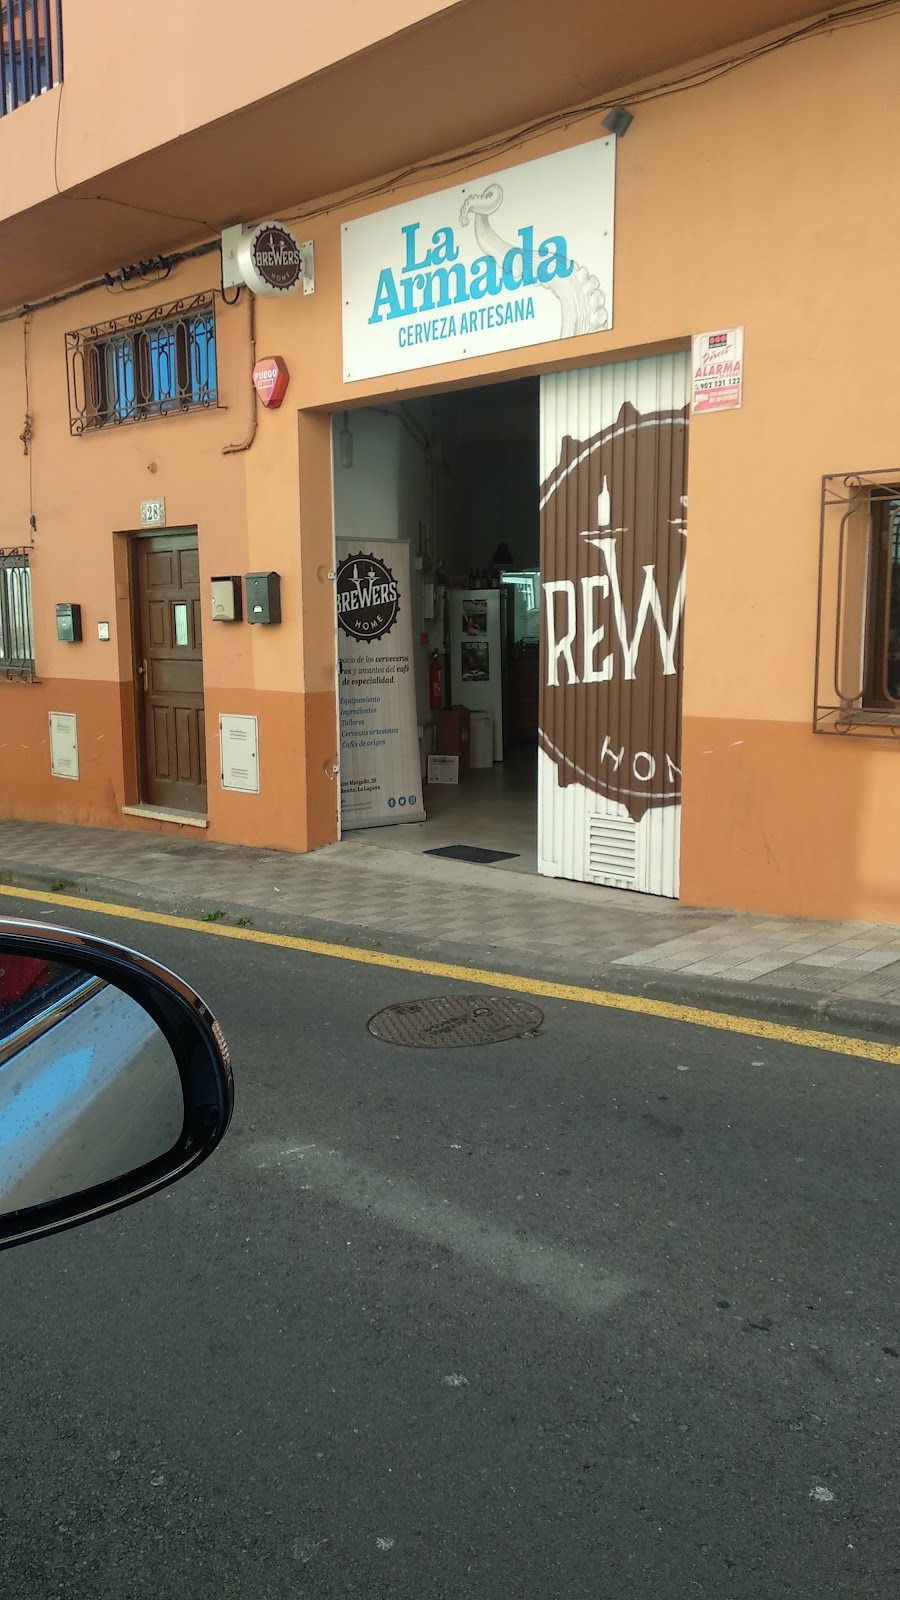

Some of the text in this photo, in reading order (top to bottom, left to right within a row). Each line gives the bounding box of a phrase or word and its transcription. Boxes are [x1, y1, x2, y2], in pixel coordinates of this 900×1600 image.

[401, 222, 459, 274] La
[256, 246, 300, 267] BREWERS
[271, 271, 290, 282] HOME
[367, 225, 574, 325] Armada
[398, 297, 535, 348] CERVEZA ARTESANA
[254, 369, 277, 380] FUEGO
[695, 361, 740, 379] ALARMA
[147, 504, 159, 521] 28
[354, 614, 384, 631] HOME
[357, 655, 365, 663] de
[375, 655, 409, 663] cerveceros
[358, 666, 385, 674] amantes
[385, 664, 396, 673] del
[342, 675, 396, 687] de especialidad.
[340, 695, 381, 706] Equipamiento
[340, 707, 377, 717] Ingredientes
[341, 718, 365, 727] Talleres
[341, 727, 399, 738] Cervezas artesanas
[359, 739, 366, 747] de
[366, 738, 386, 748] origen
